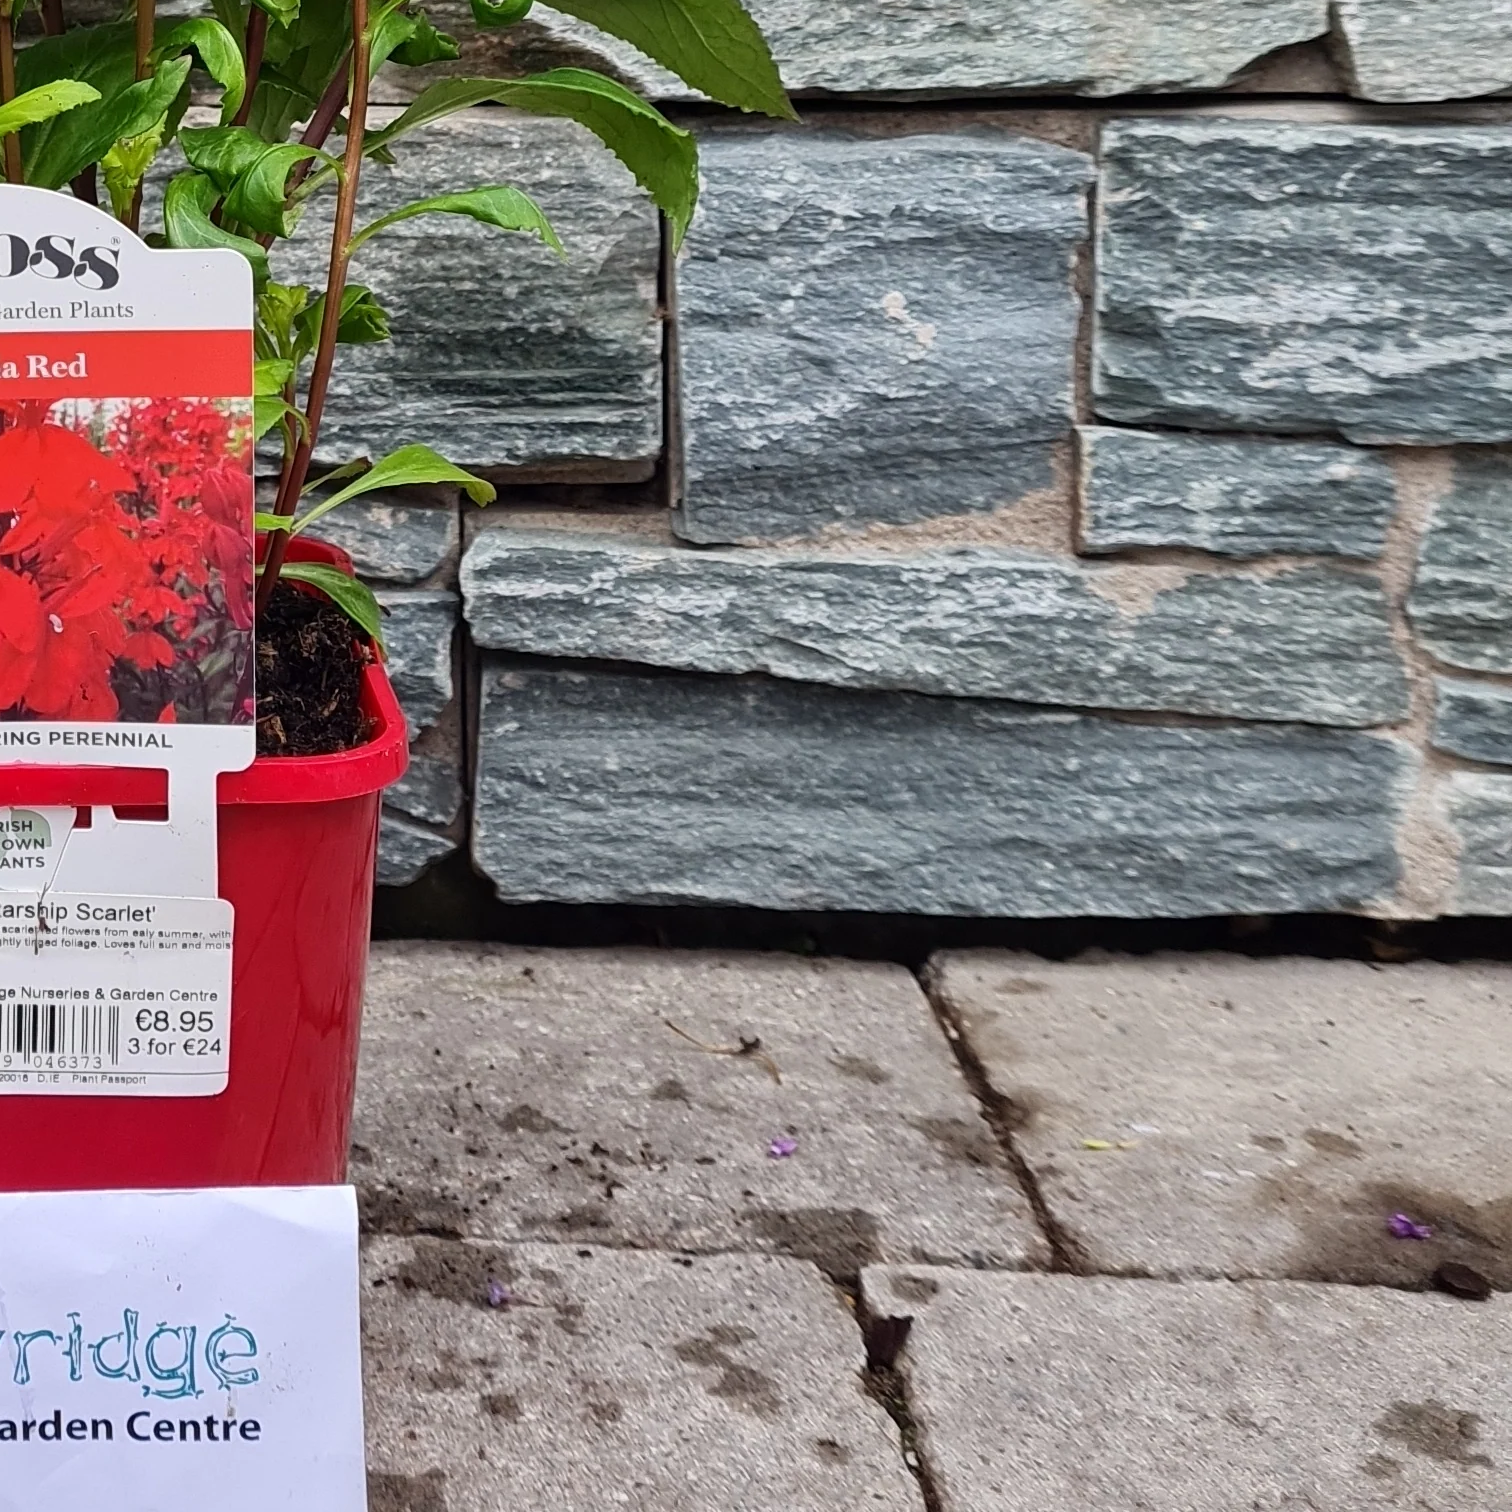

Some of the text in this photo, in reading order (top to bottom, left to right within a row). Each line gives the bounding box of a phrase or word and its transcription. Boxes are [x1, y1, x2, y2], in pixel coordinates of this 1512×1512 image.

[69, 300, 134, 319] Plants
[26, 353, 88, 379] Red
[48, 731, 174, 749] PERENNIAL
[76, 902, 156, 922] Scarlet'
[61, 925, 101, 936] flowers
[104, 927, 129, 937] from
[158, 930, 206, 940] summer,
[209, 930, 231, 939] with
[104, 939, 136, 949] Loves
[139, 939, 155, 949] full
[158, 941, 178, 949] sun
[181, 940, 202, 950] and
[21, 986, 89, 1000] Nurseries
[95, 987, 105, 1001] &
[110, 988, 165, 1002] Garden
[170, 990, 218, 1002] Centre
[135, 1009, 214, 1033] €8.95
[127, 1037, 222, 1057] 3 for €24
[33, 1055, 103, 1069] 046373
[72, 1074, 98, 1084] Plant
[101, 1074, 147, 1085] Passport
[126, 1411, 262, 1444] Centre
